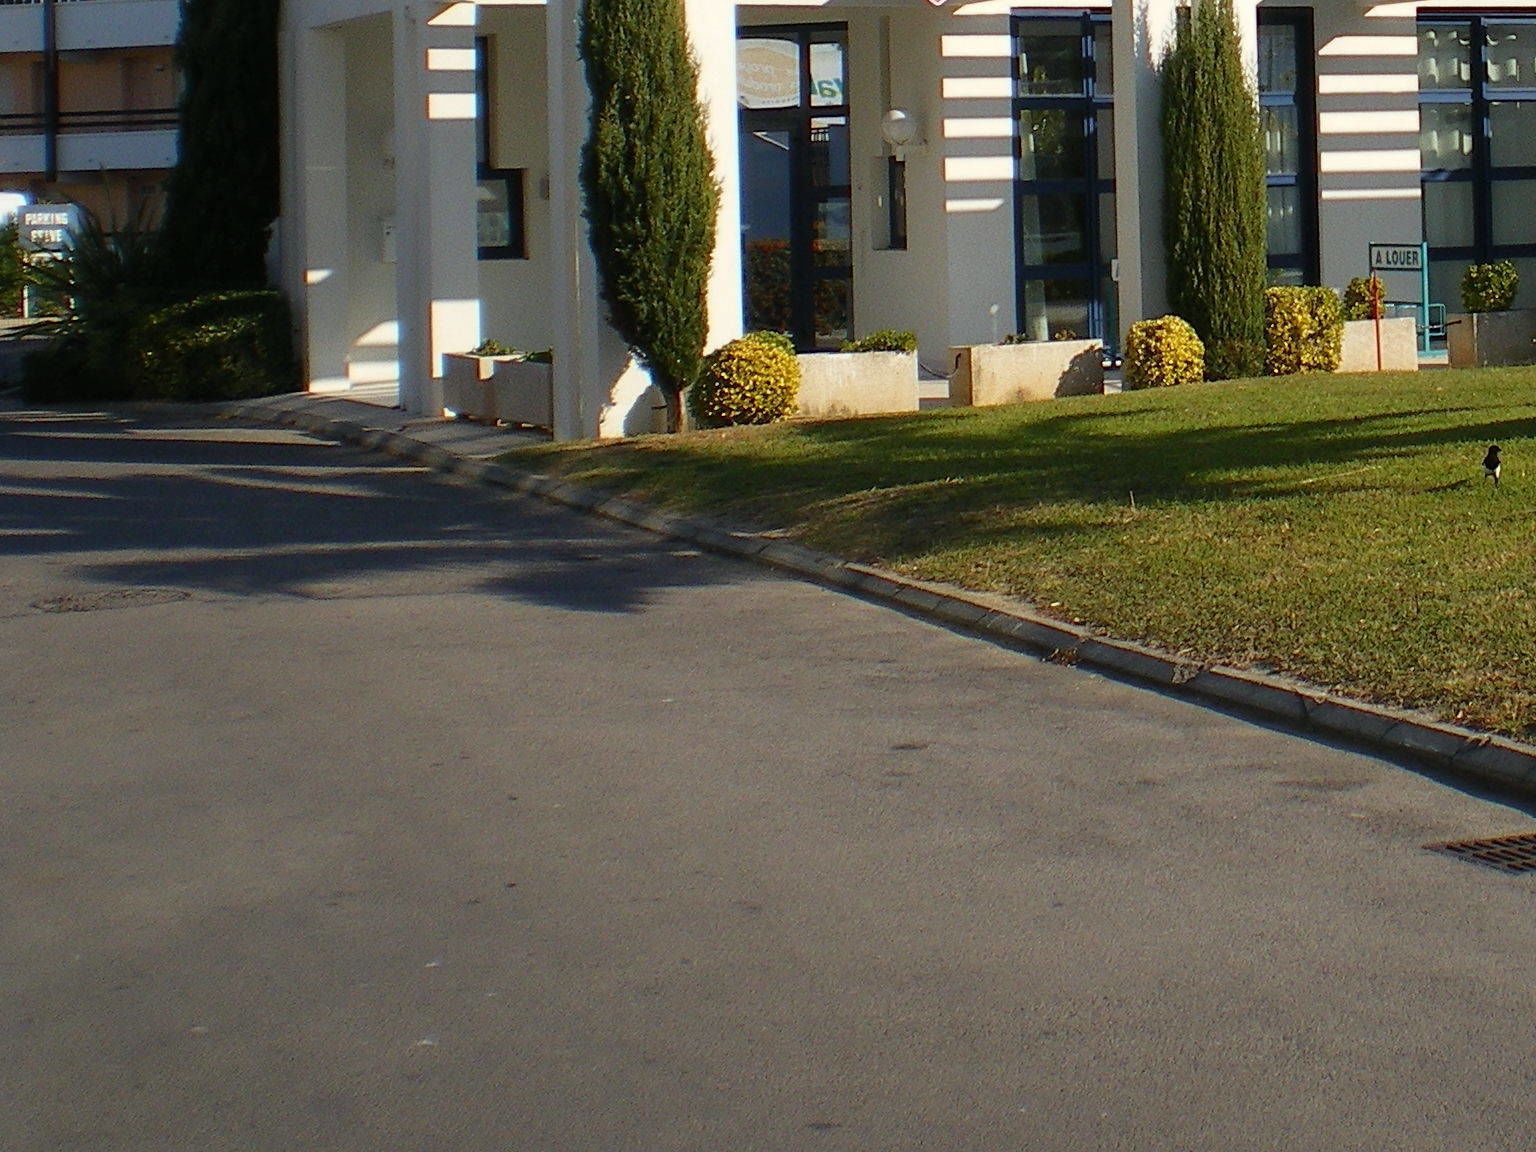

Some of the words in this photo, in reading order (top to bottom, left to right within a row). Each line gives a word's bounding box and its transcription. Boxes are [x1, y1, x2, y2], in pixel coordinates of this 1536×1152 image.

[25, 212, 68, 226] PARKING
[1376, 250, 1382, 264] A
[1386, 250, 1419, 265] LOUER
